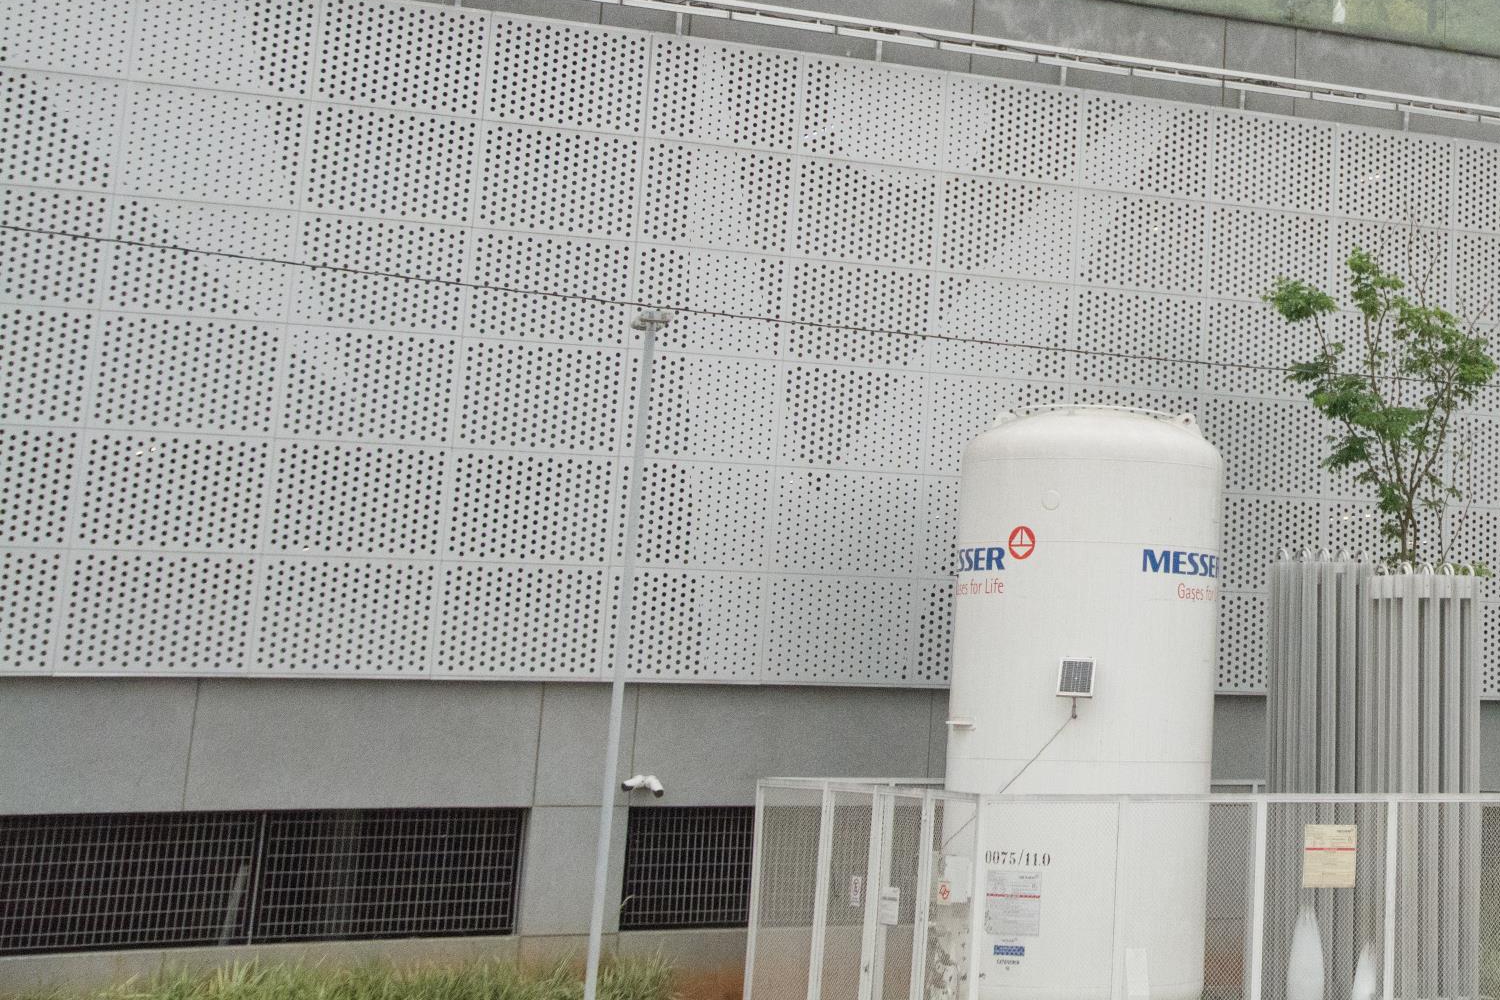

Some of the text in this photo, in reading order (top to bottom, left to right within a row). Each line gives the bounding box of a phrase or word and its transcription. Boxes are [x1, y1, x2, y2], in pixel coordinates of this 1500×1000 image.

[957, 547, 1006, 572] SSER
[970, 578, 982, 595] for
[985, 577, 1005, 594] Life
[1177, 583, 1204, 601] Gases
